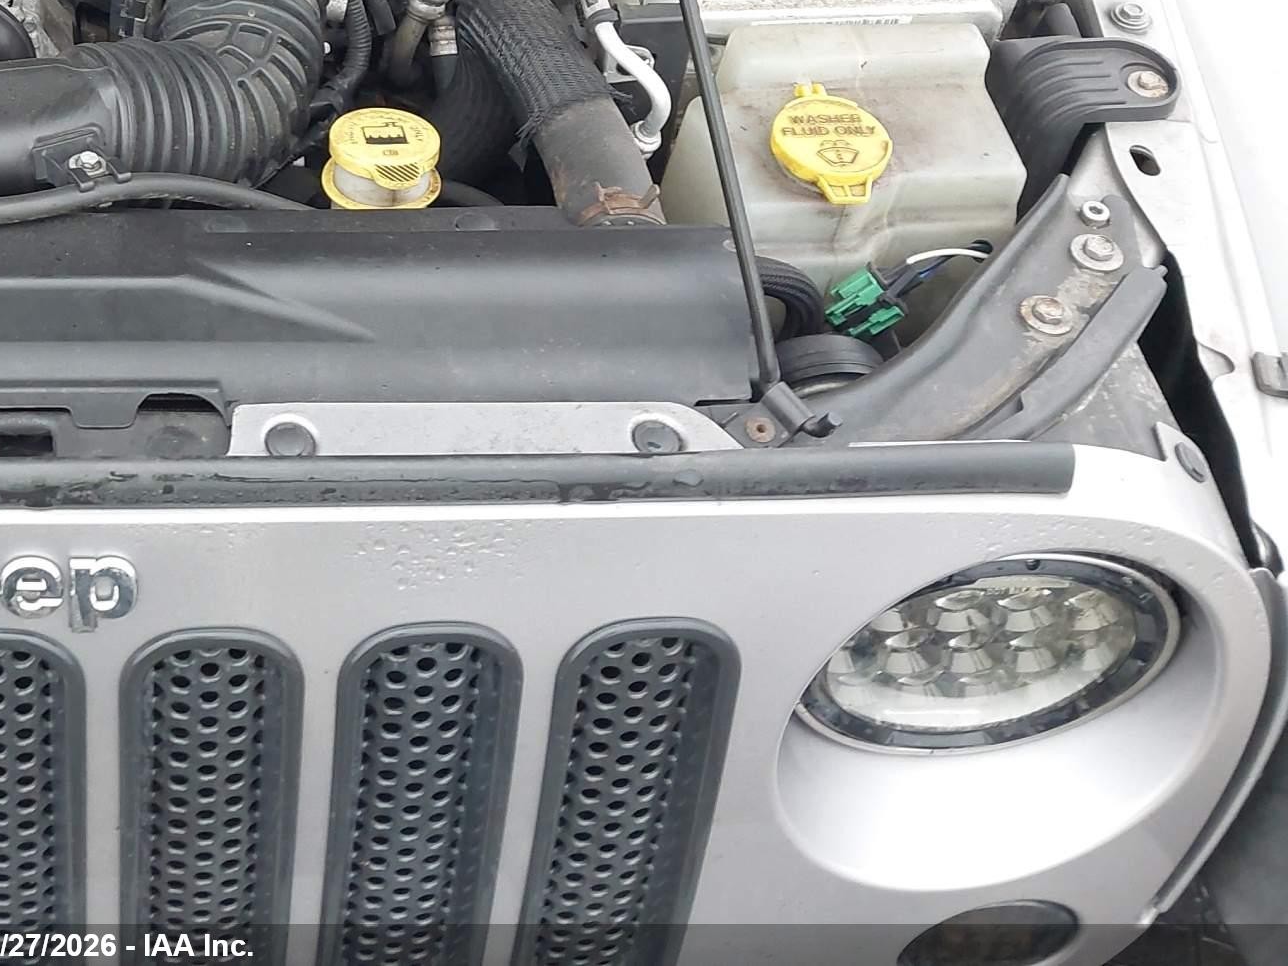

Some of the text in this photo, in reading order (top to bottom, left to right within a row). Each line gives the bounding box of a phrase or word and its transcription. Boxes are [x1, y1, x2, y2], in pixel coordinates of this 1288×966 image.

[789, 113, 862, 125] WASHER
[781, 125, 876, 137] FLUID ONLY
